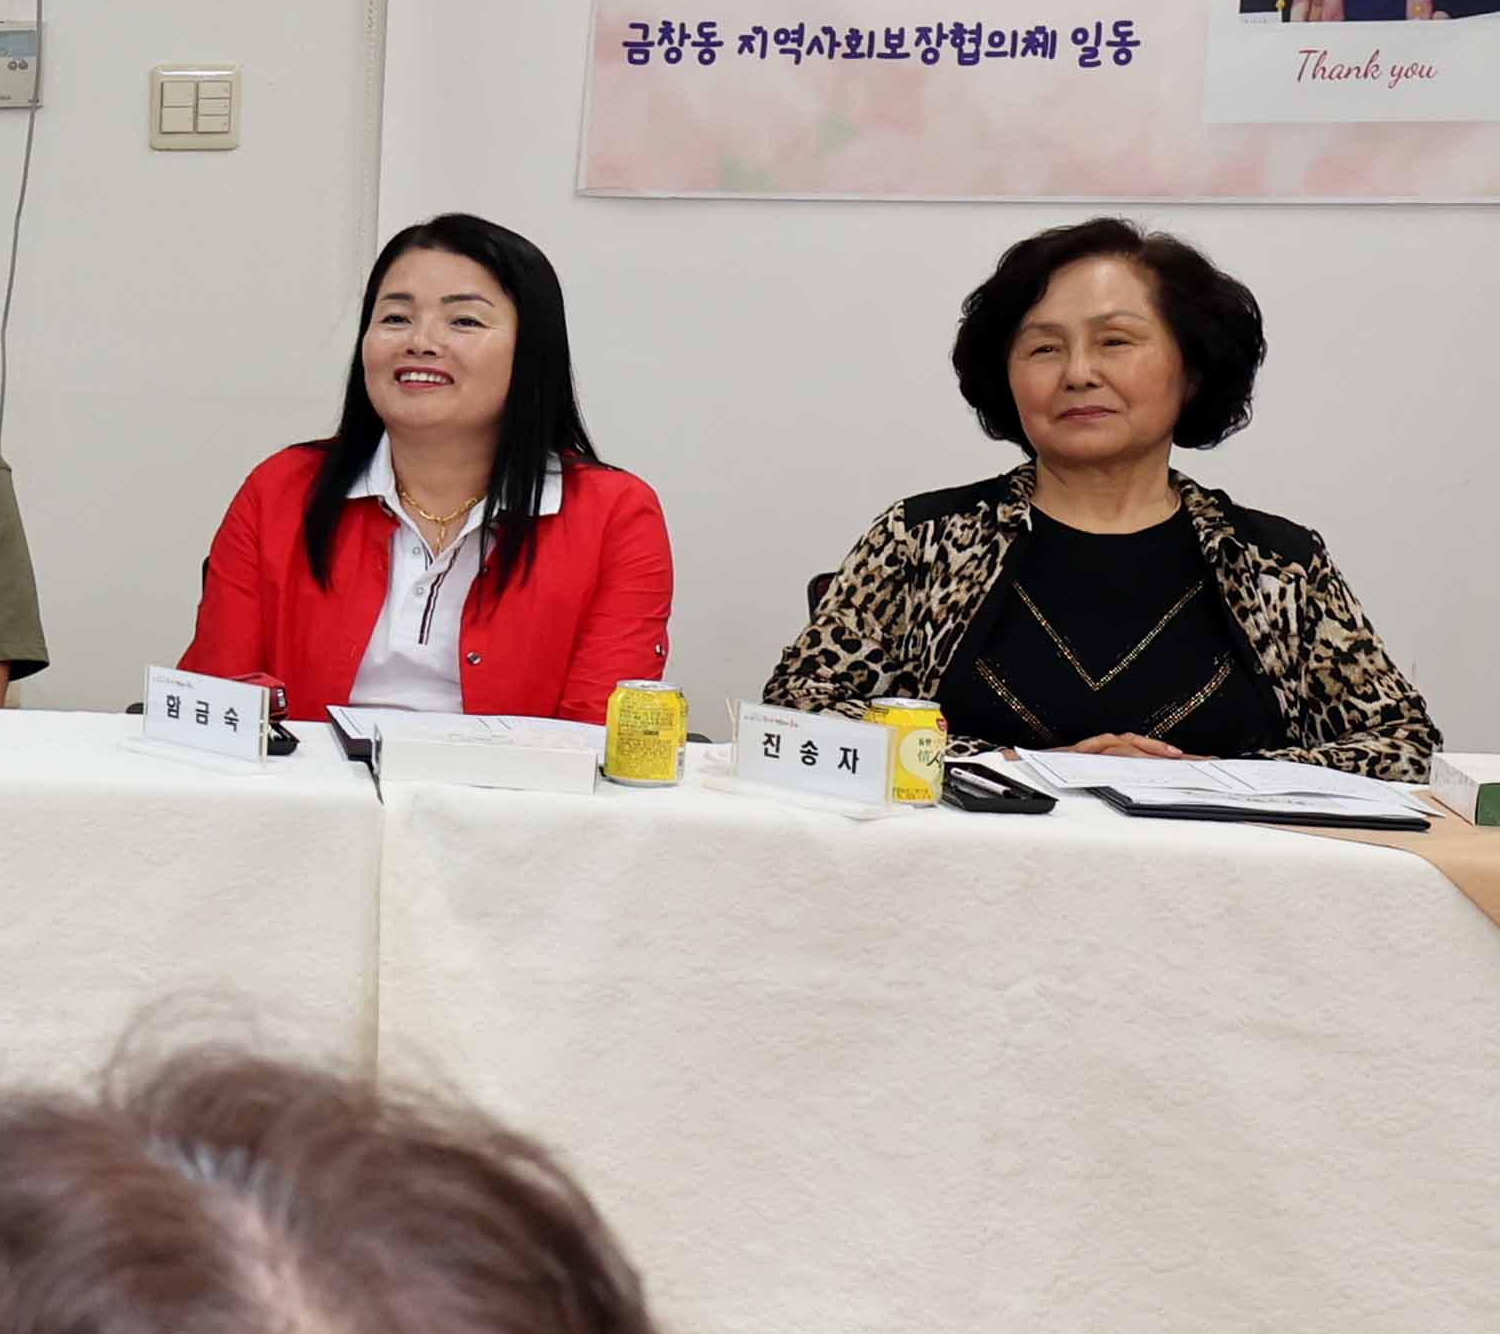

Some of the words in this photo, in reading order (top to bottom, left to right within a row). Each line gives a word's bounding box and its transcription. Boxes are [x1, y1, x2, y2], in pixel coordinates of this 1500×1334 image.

[621, 20, 725, 66] 금창동
[736, 23, 1058, 66] 지역사회보장협의체
[1069, 20, 1142, 67] 일동
[1296, 48, 1381, 84] Thank
[1387, 60, 1439, 88] you
[798, 739, 820, 767] 송
[836, 746, 860, 775] 자
